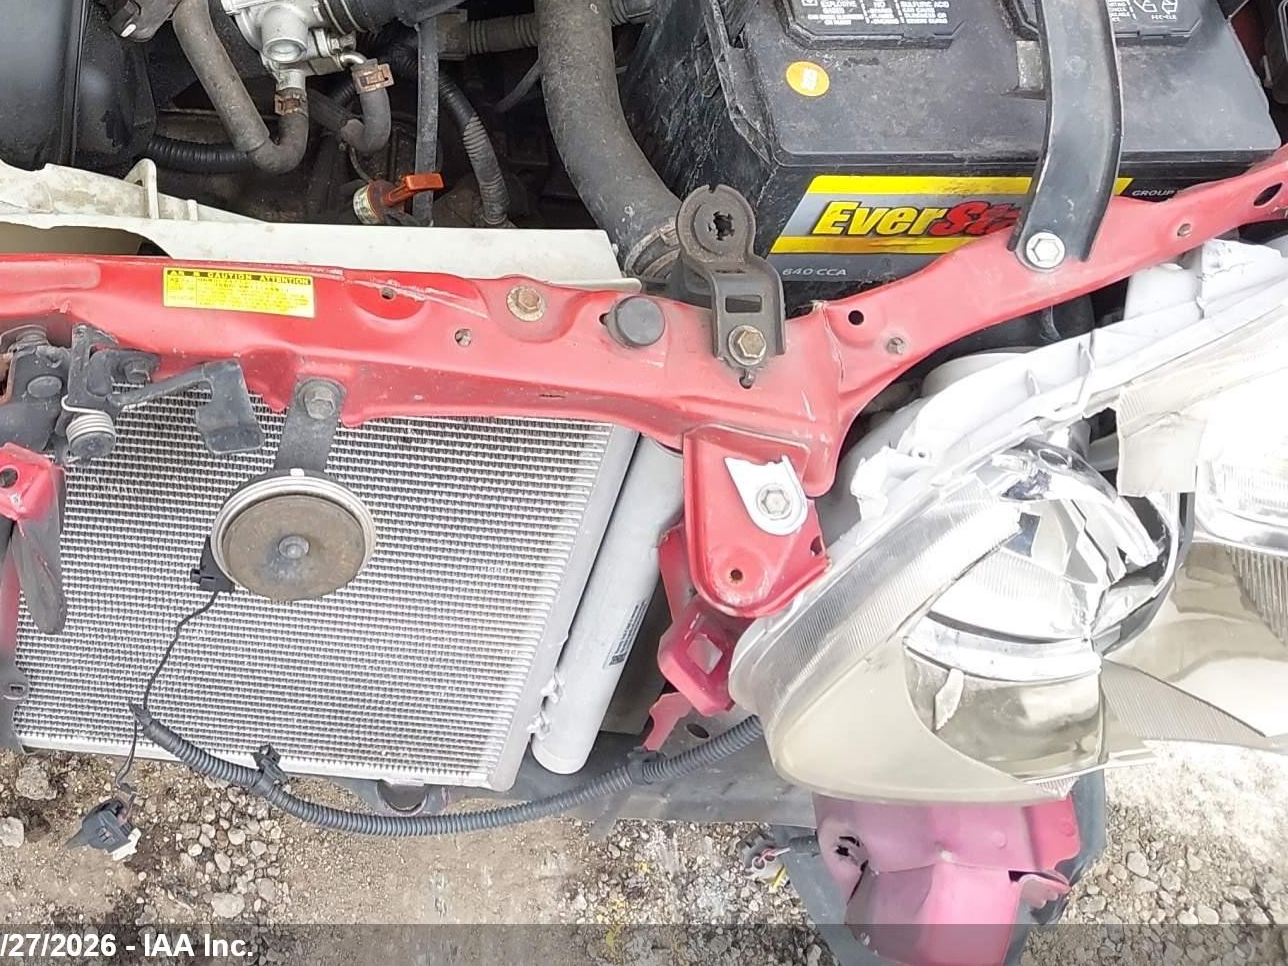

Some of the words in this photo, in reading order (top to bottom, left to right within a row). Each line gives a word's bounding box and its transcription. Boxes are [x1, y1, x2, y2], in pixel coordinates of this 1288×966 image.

[1132, 189, 1175, 197] GROUP
[782, 267, 813, 276] 640
[815, 268, 847, 276] CCA
[207, 271, 253, 281] CAUTION
[260, 274, 310, 285] ATTENTION
